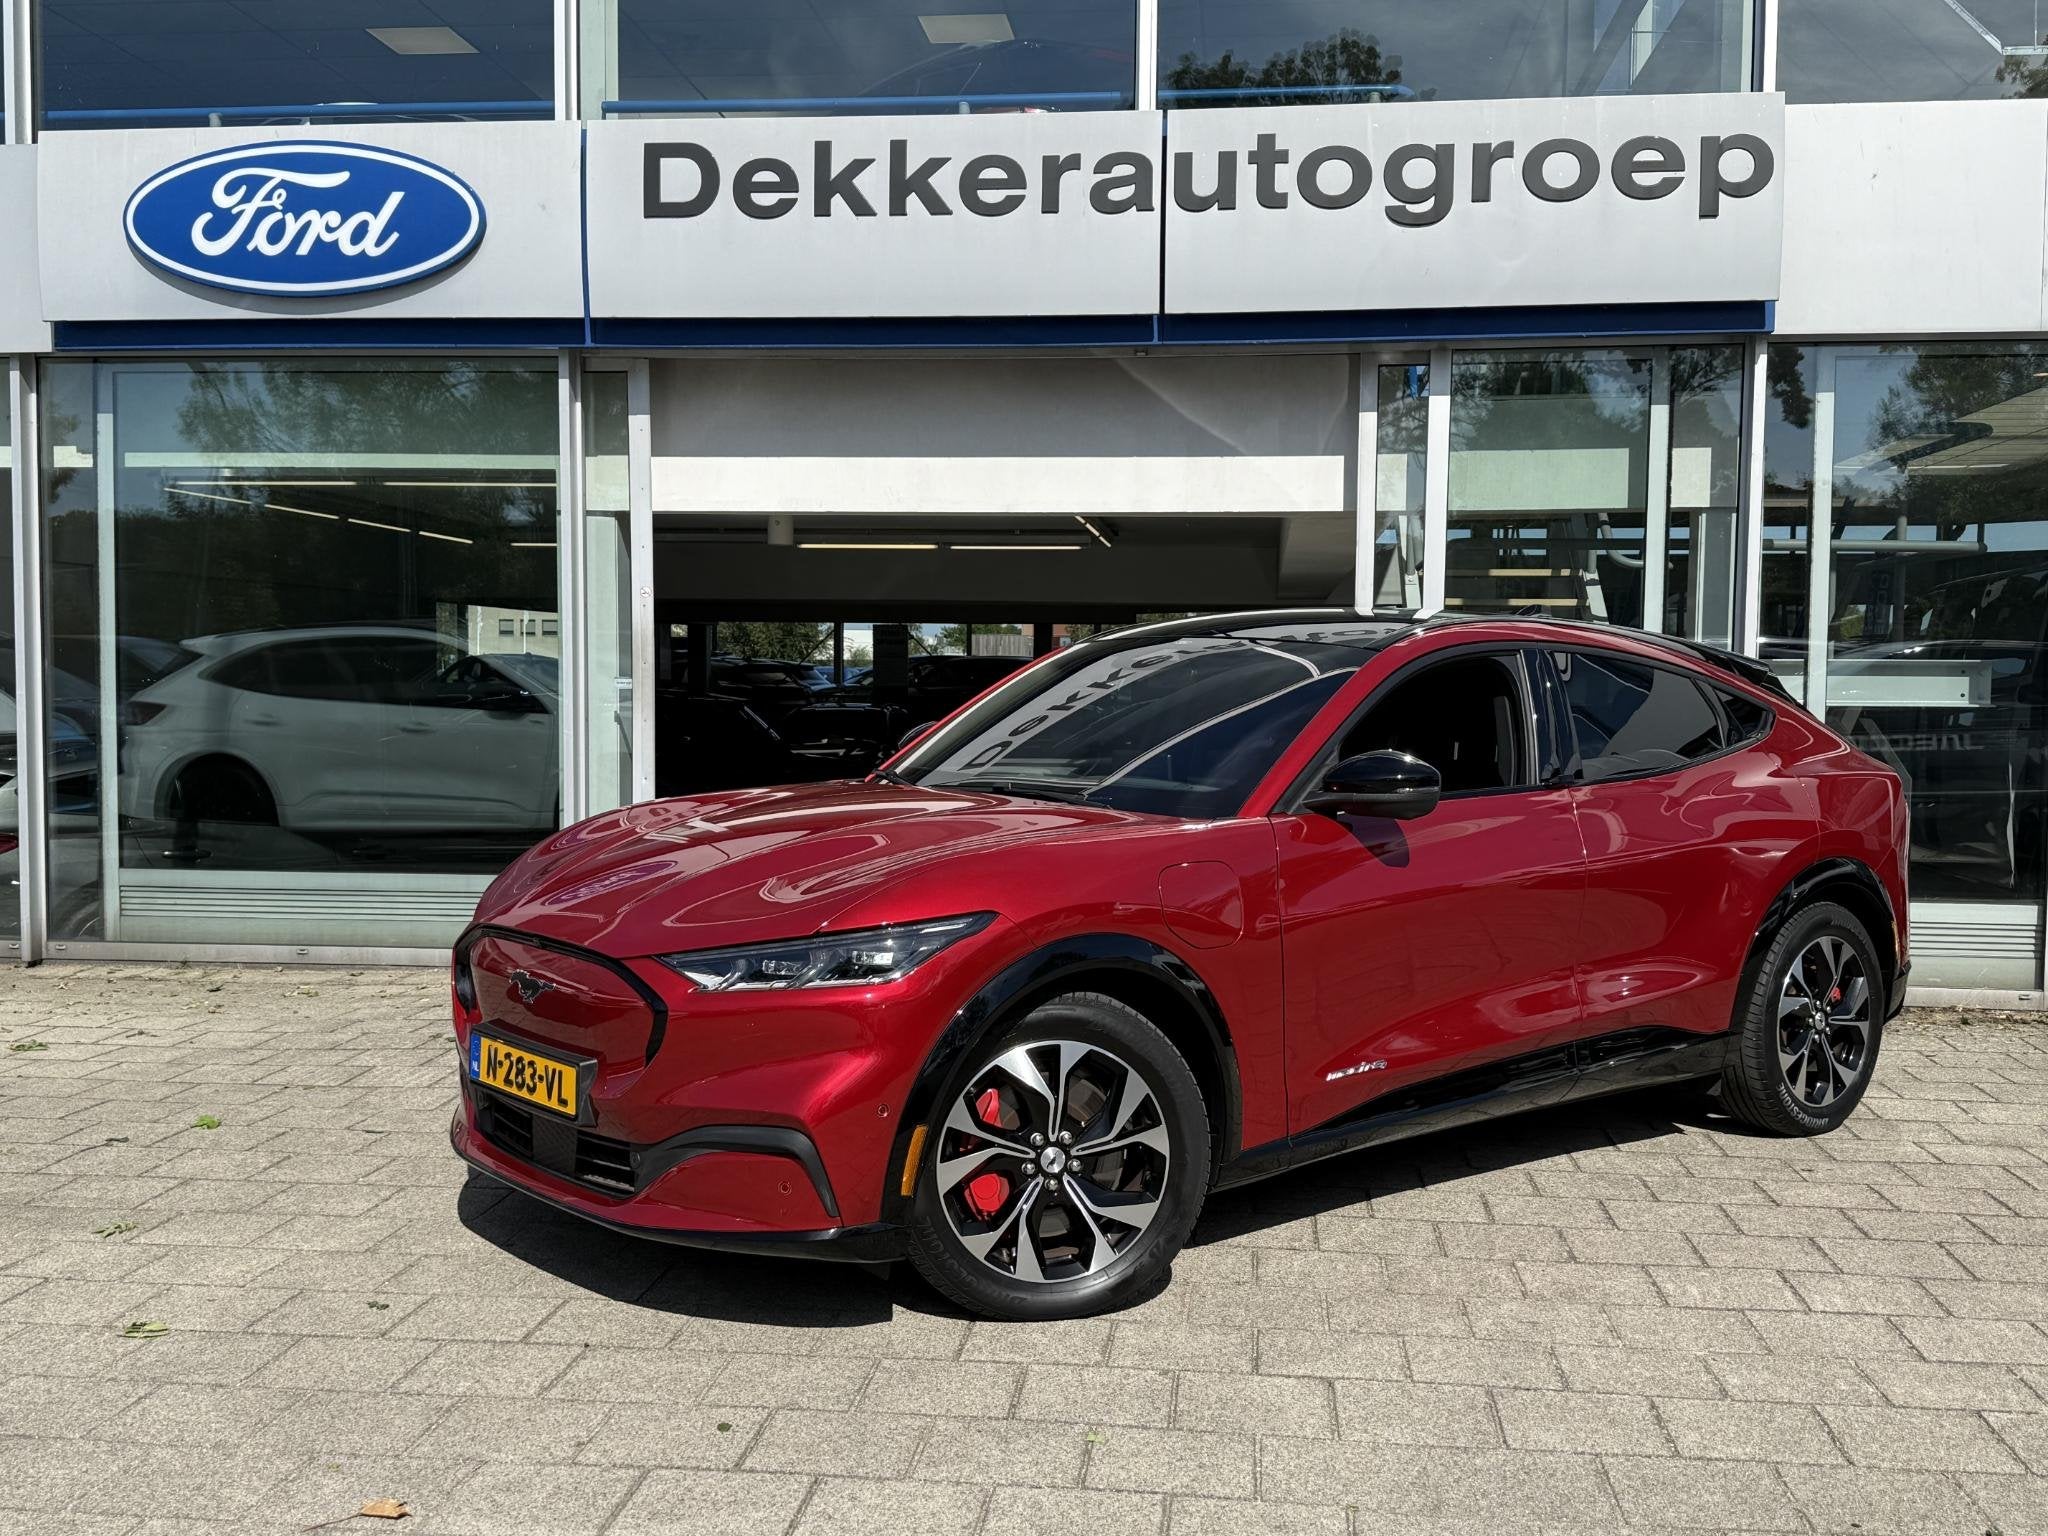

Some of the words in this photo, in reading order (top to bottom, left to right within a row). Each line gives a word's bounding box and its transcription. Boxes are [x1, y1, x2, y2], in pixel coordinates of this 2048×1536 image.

[191, 168, 405, 256] Ford
[643, 133, 1775, 227] Dekkerautogroep
[486, 1044, 569, 1108] N-283-VL
